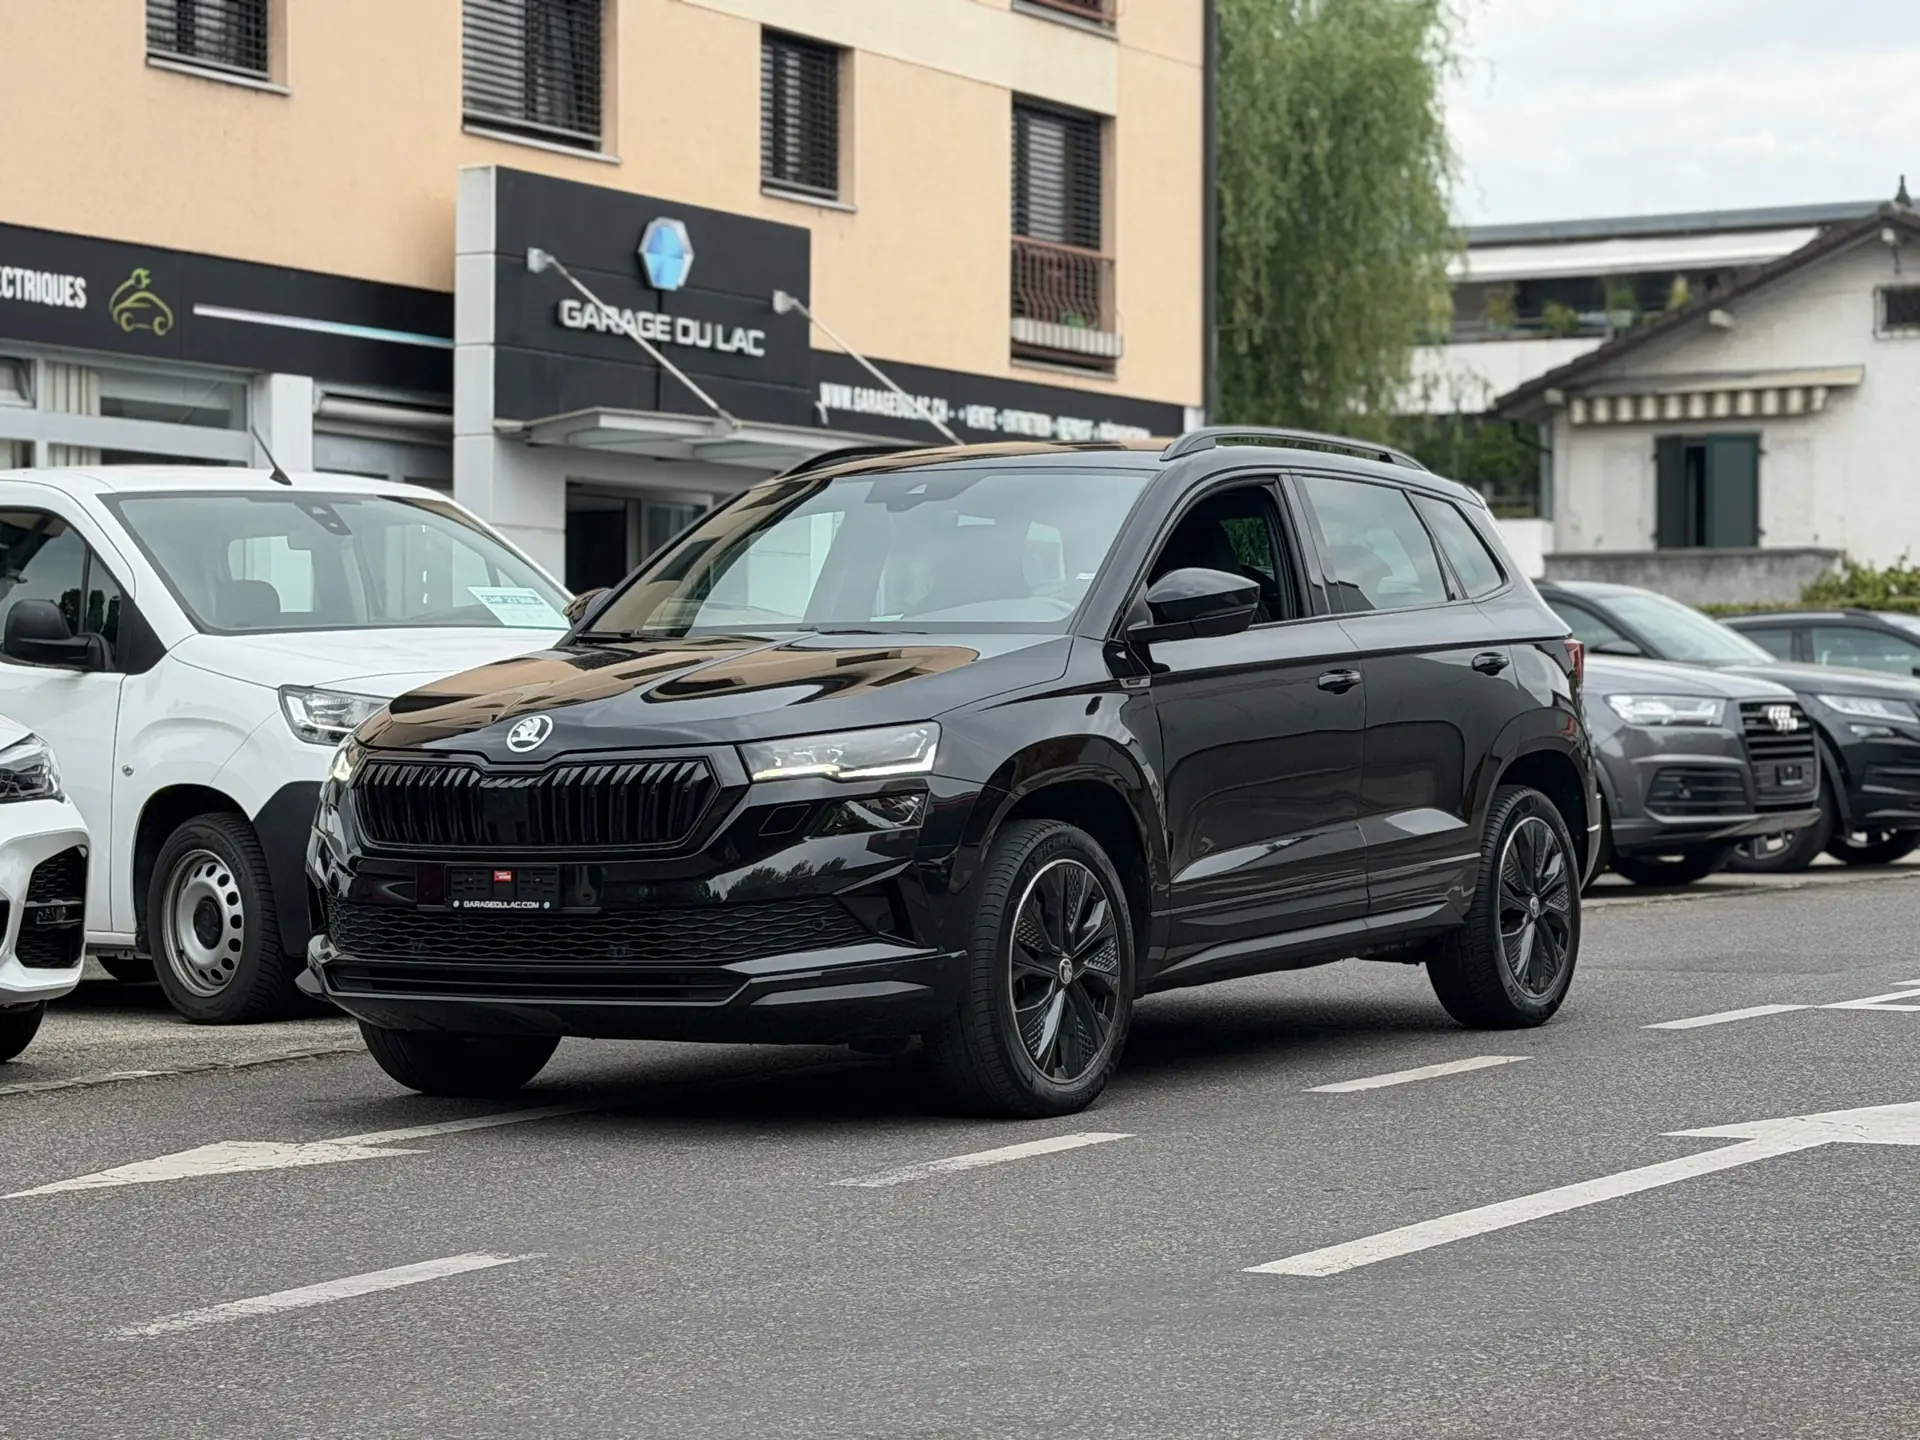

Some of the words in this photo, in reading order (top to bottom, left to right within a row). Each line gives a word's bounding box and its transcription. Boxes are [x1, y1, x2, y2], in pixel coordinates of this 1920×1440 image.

[0, 264, 87, 310] CTRIQUES
[559, 299, 672, 342] GARAGE
[676, 316, 713, 348] DU
[716, 323, 766, 357] LAC
